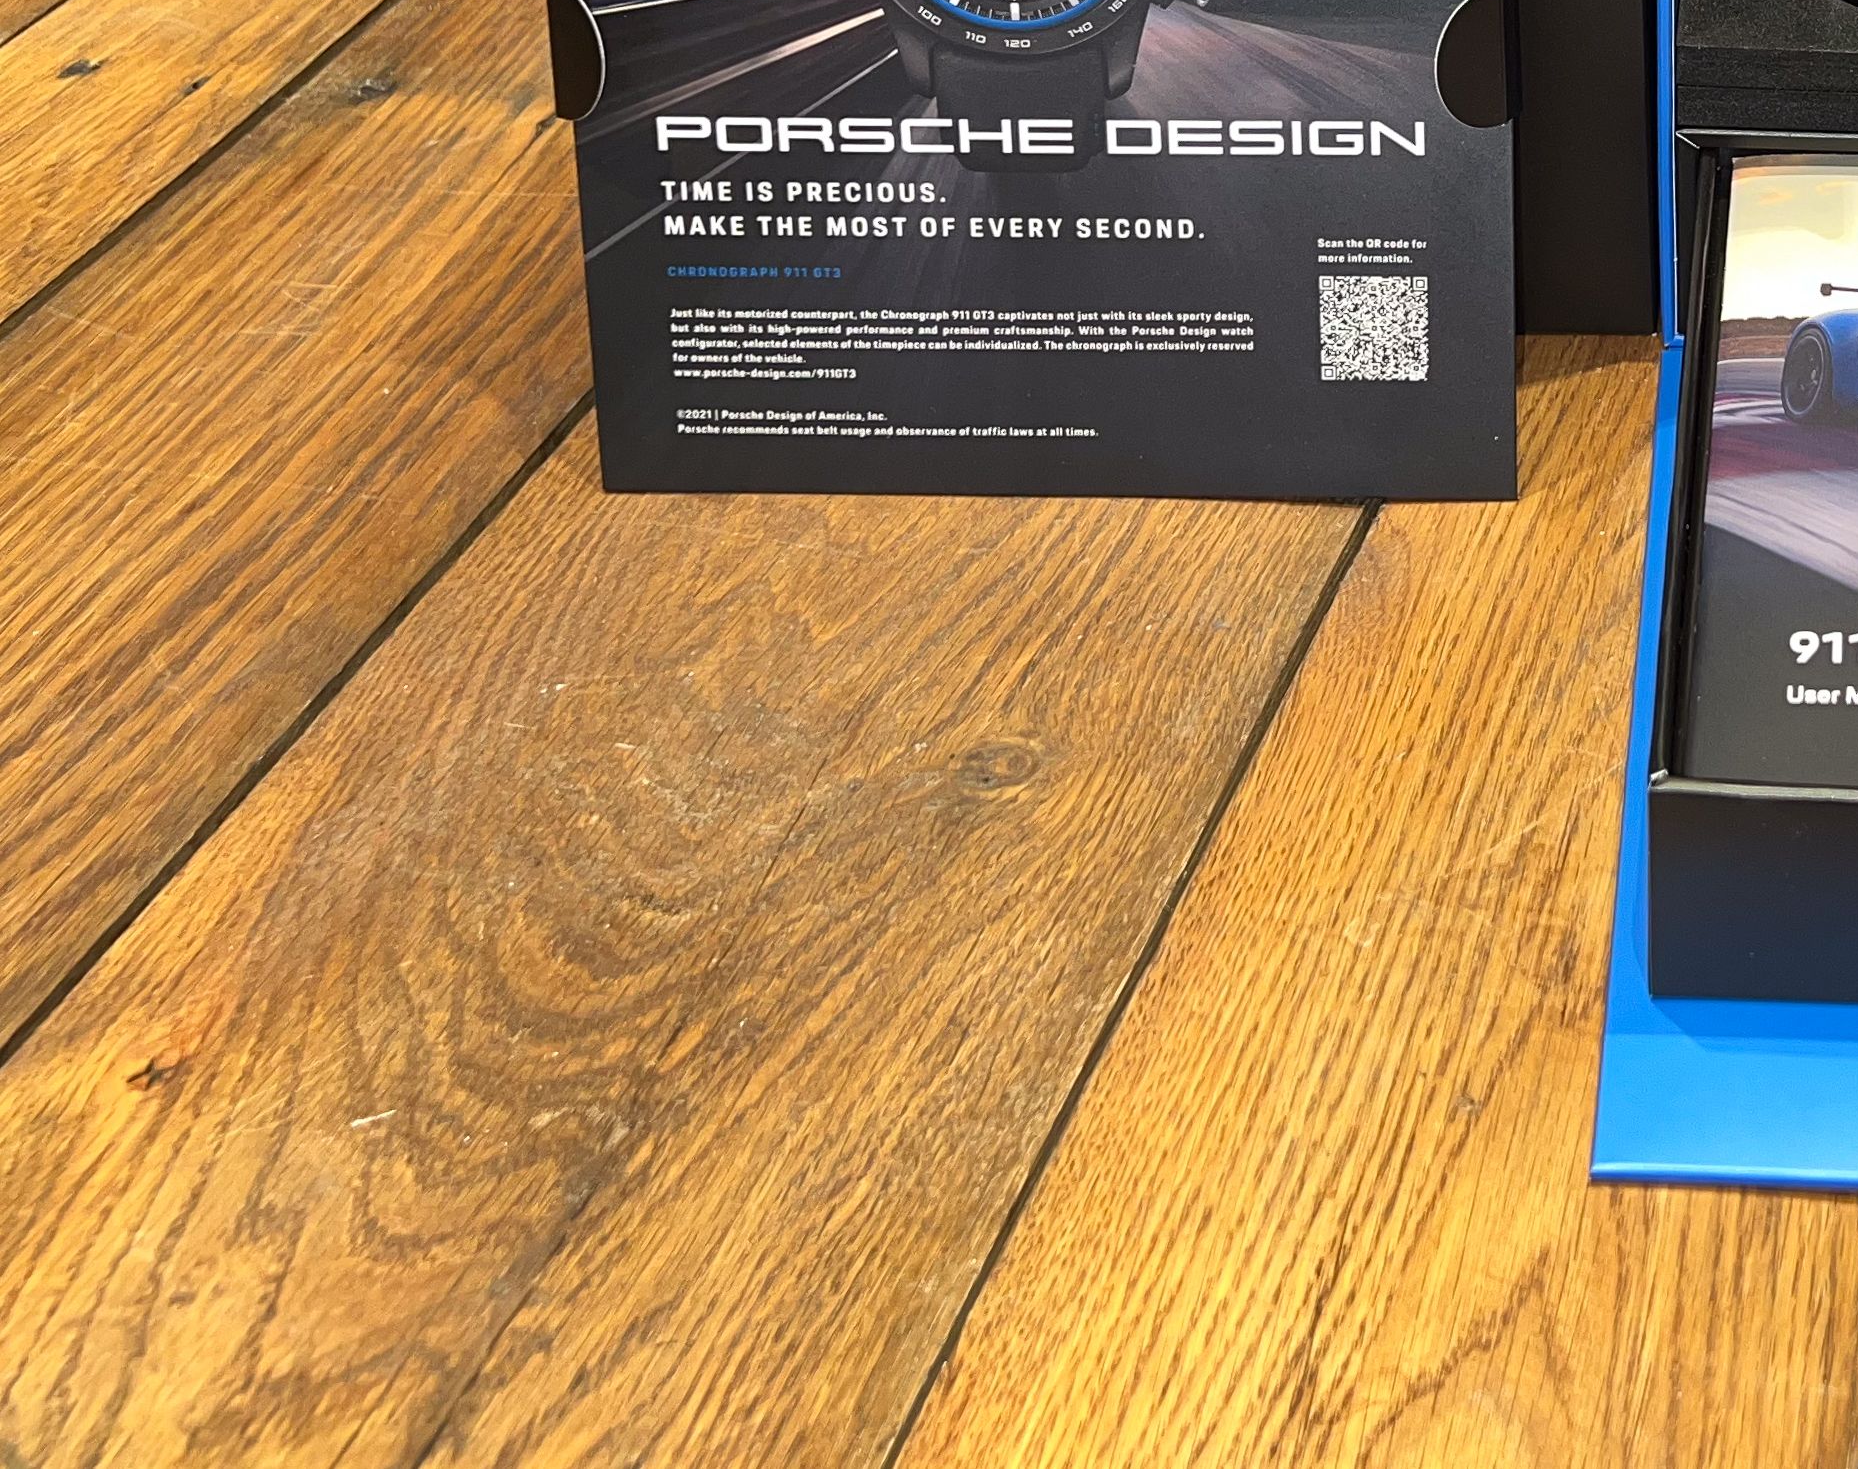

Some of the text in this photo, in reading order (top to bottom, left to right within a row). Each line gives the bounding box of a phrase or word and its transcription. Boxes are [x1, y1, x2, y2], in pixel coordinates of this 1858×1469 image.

[917, 5, 942, 27] 100
[1067, 21, 1094, 37] 140
[964, 31, 987, 45] 110
[1004, 39, 1031, 48] 120
[655, 116, 1426, 156] PORSCHE DESIGN
[660, 180, 946, 203] TIME IS PRECIOUS.
[664, 215, 1205, 239] MAKE THE MOST OF EVERY SECOND.
[1317, 237, 1427, 249] Scan the QR code for
[1317, 252, 1413, 264] more information.
[667, 266, 841, 279] CHRONOGRAPH 911 GT3
[670, 308, 1254, 324] Just like its motorized counterpart, the Chronograph 911 GT3 captivates not just with its sleek sporty design,
[670, 322, 1254, 338] but also with its high-powered performance and premium craftsmanship. With the Porsche Design watch
[671, 337, 1254, 353] configurator, selected elements of the timepiece can be individualized. The chronograph is exclusively reserved
[672, 352, 808, 364] for owners of the vehicle.
[673, 367, 857, 381] www.porsche-design.com/911GT3
[721, 409, 764, 420] Porsche
[765, 410, 804, 423] Design
[804, 410, 817, 421] of
[817, 410, 866, 422] America,
[866, 411, 888, 421] Inc.
[677, 423, 1099, 438] Porsche recommends seat belt usage and observance of traffic laws at all times.
[1786, 684, 1841, 705] User
